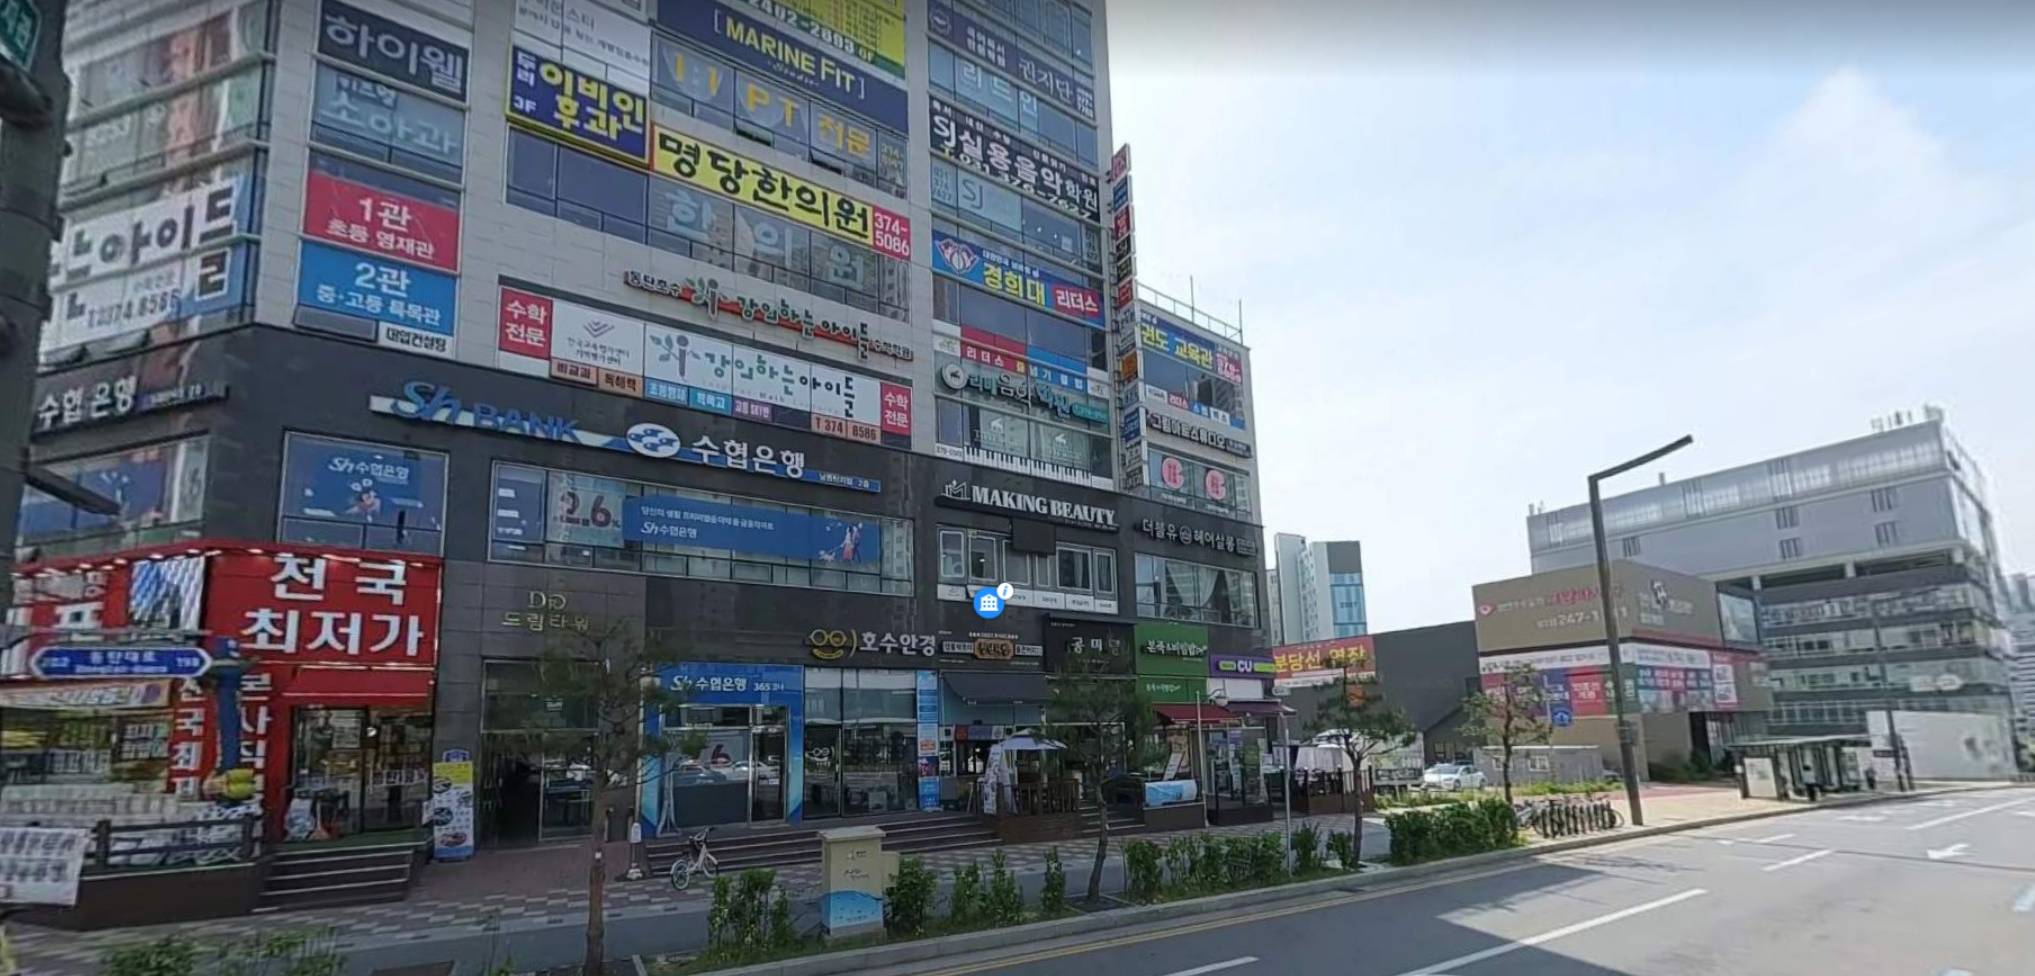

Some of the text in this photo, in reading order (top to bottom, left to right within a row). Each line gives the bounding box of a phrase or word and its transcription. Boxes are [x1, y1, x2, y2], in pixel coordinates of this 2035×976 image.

[725, 16, 856, 94] MARINE FIT
[539, 61, 645, 135] 이비인
[552, 93, 623, 141] 후과
[658, 131, 870, 240] 명당한의원
[325, 217, 370, 245] 초등
[358, 196, 414, 234] 1관
[874, 229, 911, 257] 5086
[354, 261, 412, 299] 2관
[983, 261, 1046, 307] 경희대
[1055, 289, 1099, 313] 리더스
[505, 299, 548, 325] 수학
[505, 321, 546, 347] 전문
[390, 380, 581, 444] Sh BANK
[884, 391, 911, 411] 수학
[884, 406, 910, 429] 전문
[823, 418, 844, 435] 374
[851, 423, 878, 441] 8586
[692, 434, 806, 479] 수협은행
[971, 485, 1049, 515] MAKING
[1050, 499, 1117, 526] BEAUTY
[269, 555, 407, 606] 전국
[241, 610, 425, 656] 최저가
[501, 611, 593, 632] 드림타워
[858, 630, 937, 657] 호수안경
[695, 674, 748, 693] 수협은행
[753, 680, 771, 693] 365
[1237, 660, 1253, 673] CU
